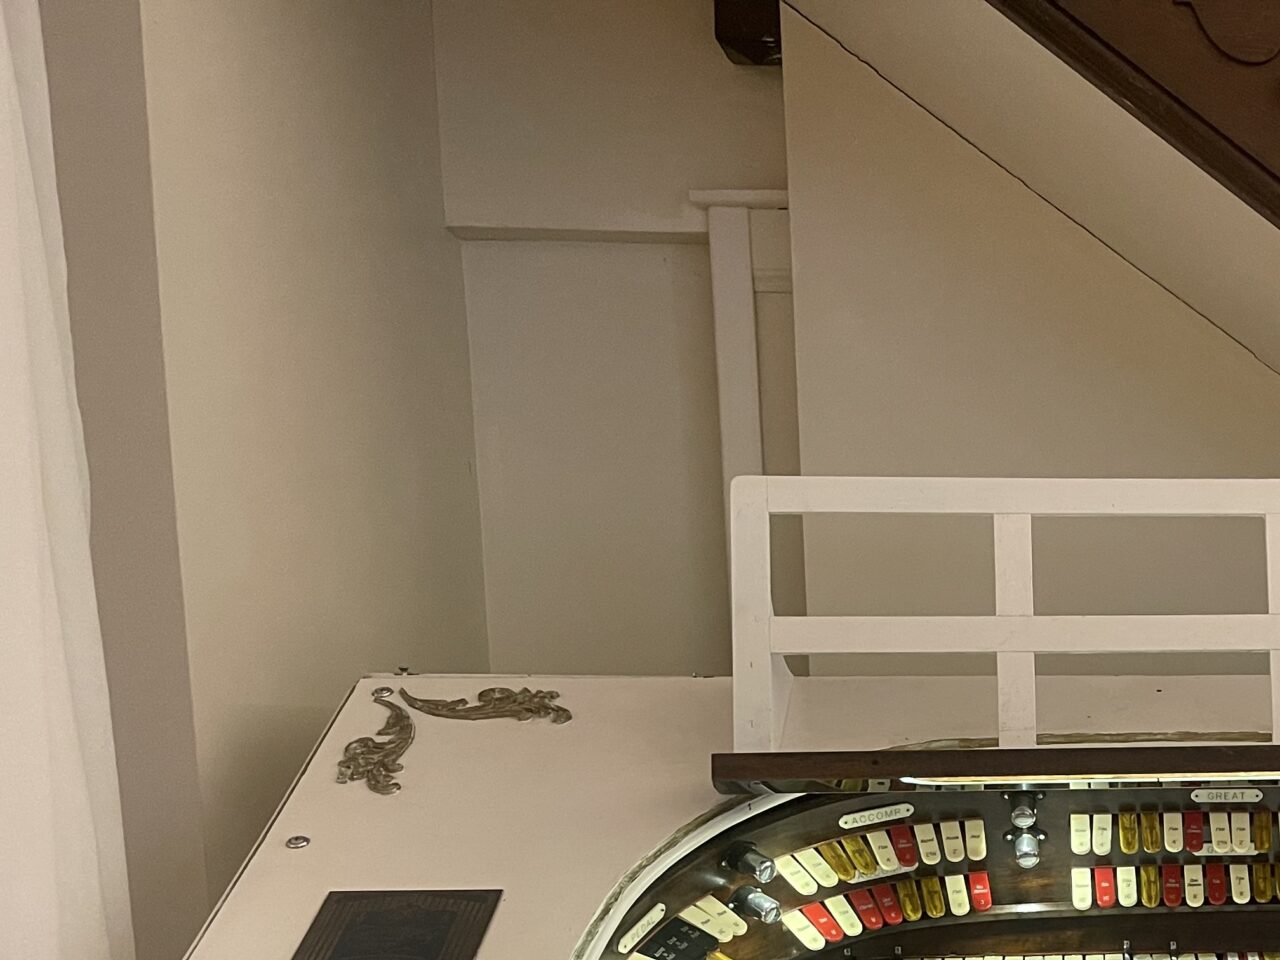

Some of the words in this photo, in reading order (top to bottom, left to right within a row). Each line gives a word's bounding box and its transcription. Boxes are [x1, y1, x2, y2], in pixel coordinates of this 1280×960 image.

[1207, 790, 1247, 801] GREAT
[851, 807, 902, 825] ACCOMP
[630, 916, 656, 943] PEDAL
